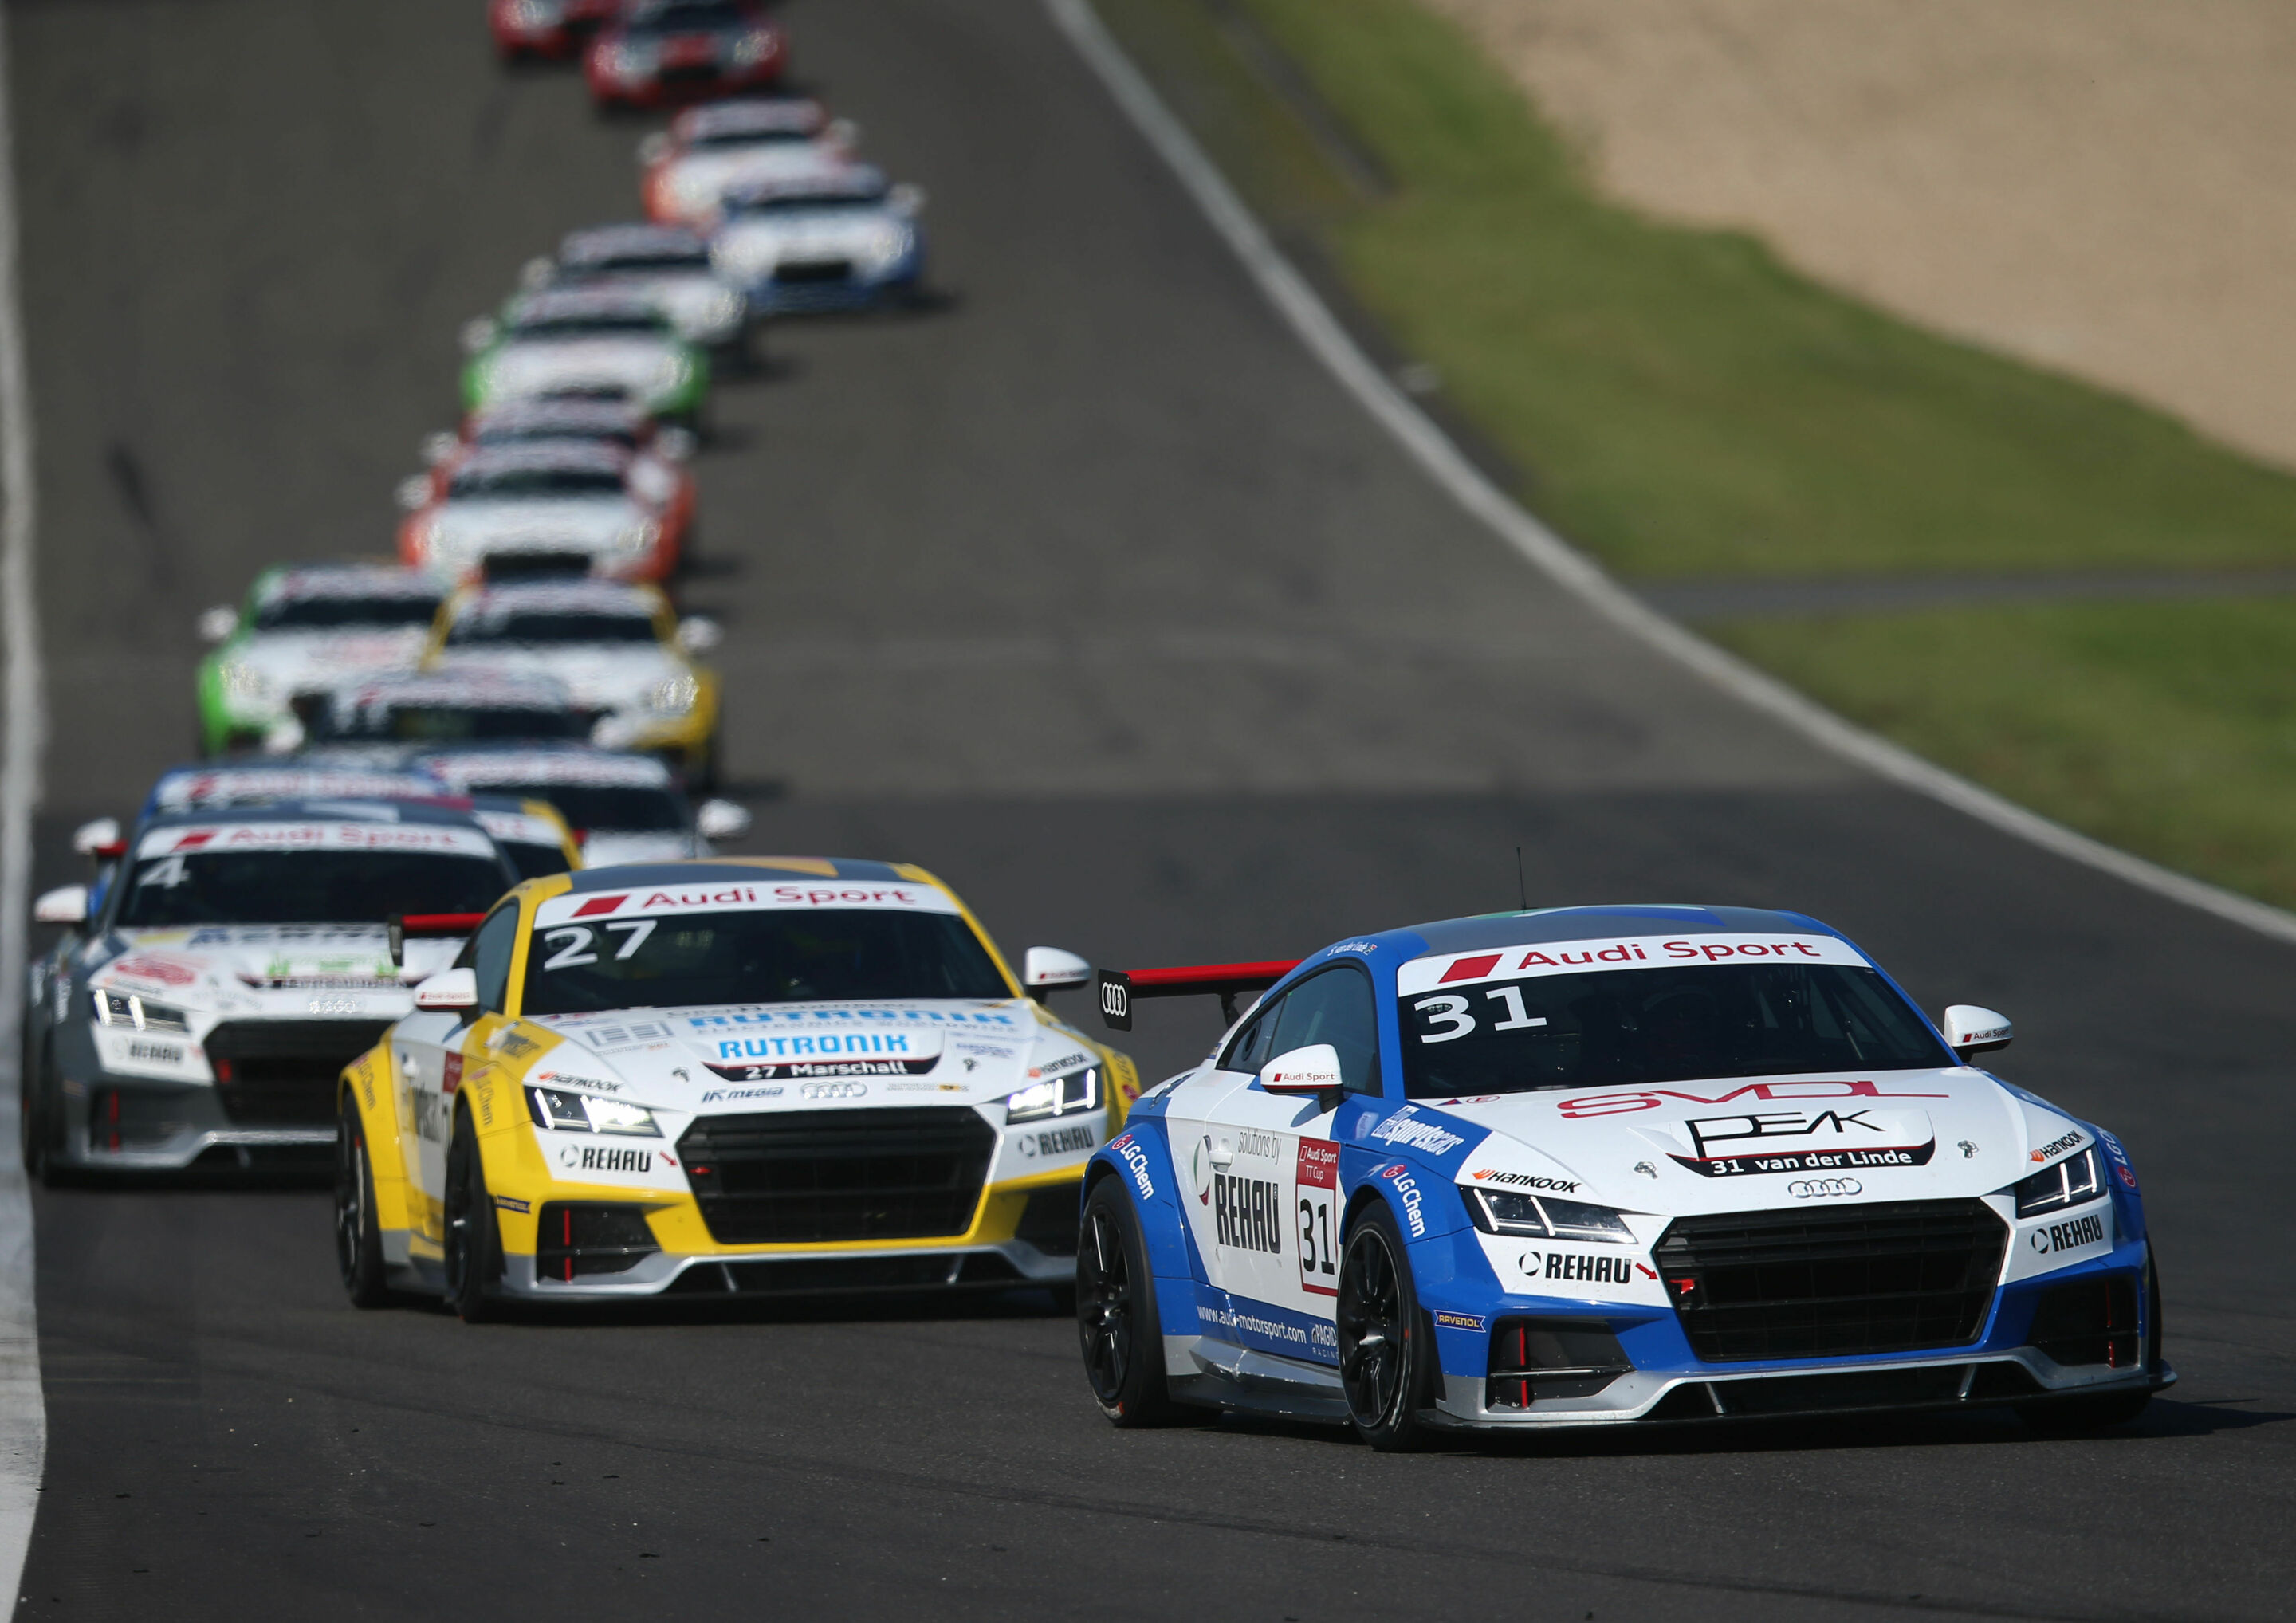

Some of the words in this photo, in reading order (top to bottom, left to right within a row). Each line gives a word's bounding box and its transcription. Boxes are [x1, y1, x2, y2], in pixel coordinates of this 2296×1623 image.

[228, 826, 324, 845] Audi
[337, 825, 460, 847] Sport
[138, 856, 191, 887] 4
[641, 886, 757, 909] Audi
[773, 885, 919, 906] Sport
[544, 919, 659, 972] 27
[1516, 943, 1647, 970] Audi
[1661, 941, 1821, 961] Sport
[688, 1009, 1014, 1028] RUTRONIK
[1413, 985, 1548, 1044] 31
[718, 1033, 909, 1059] RUTRONIK
[1972, 1031, 1993, 1039] Audi
[745, 1065, 777, 1079] 27
[790, 1060, 908, 1078] Marschall
[1306, 1072, 1336, 1083] Sport
[1039, 1124, 1095, 1155] REHAU
[1237, 1127, 1270, 1158] solutions
[1271, 1135, 1282, 1166] by
[1684, 1110, 1886, 1160] PEAK
[582, 1146, 653, 1173] REHAU
[1119, 1139, 1141, 1161] LG
[1307, 1146, 1320, 1161] Audi
[1320, 1150, 1337, 1165] Sport
[1711, 1159, 1744, 1176] 31
[1755, 1156, 1802, 1171] van
[1807, 1152, 1843, 1168] der
[1849, 1149, 1913, 1165] Linde
[1129, 1153, 1154, 1200] Chem
[1305, 1164, 1314, 1176] TT
[1313, 1167, 1323, 1181] Cup
[1392, 1171, 1415, 1193] LG
[1214, 1174, 1281, 1254] REHAU
[1402, 1188, 1425, 1238] Chem
[1299, 1199, 1336, 1275] 31
[2050, 1214, 2104, 1252] REHAU
[1545, 1253, 1633, 1284] REHAU
[1438, 1314, 1480, 1329] RAVENOL
